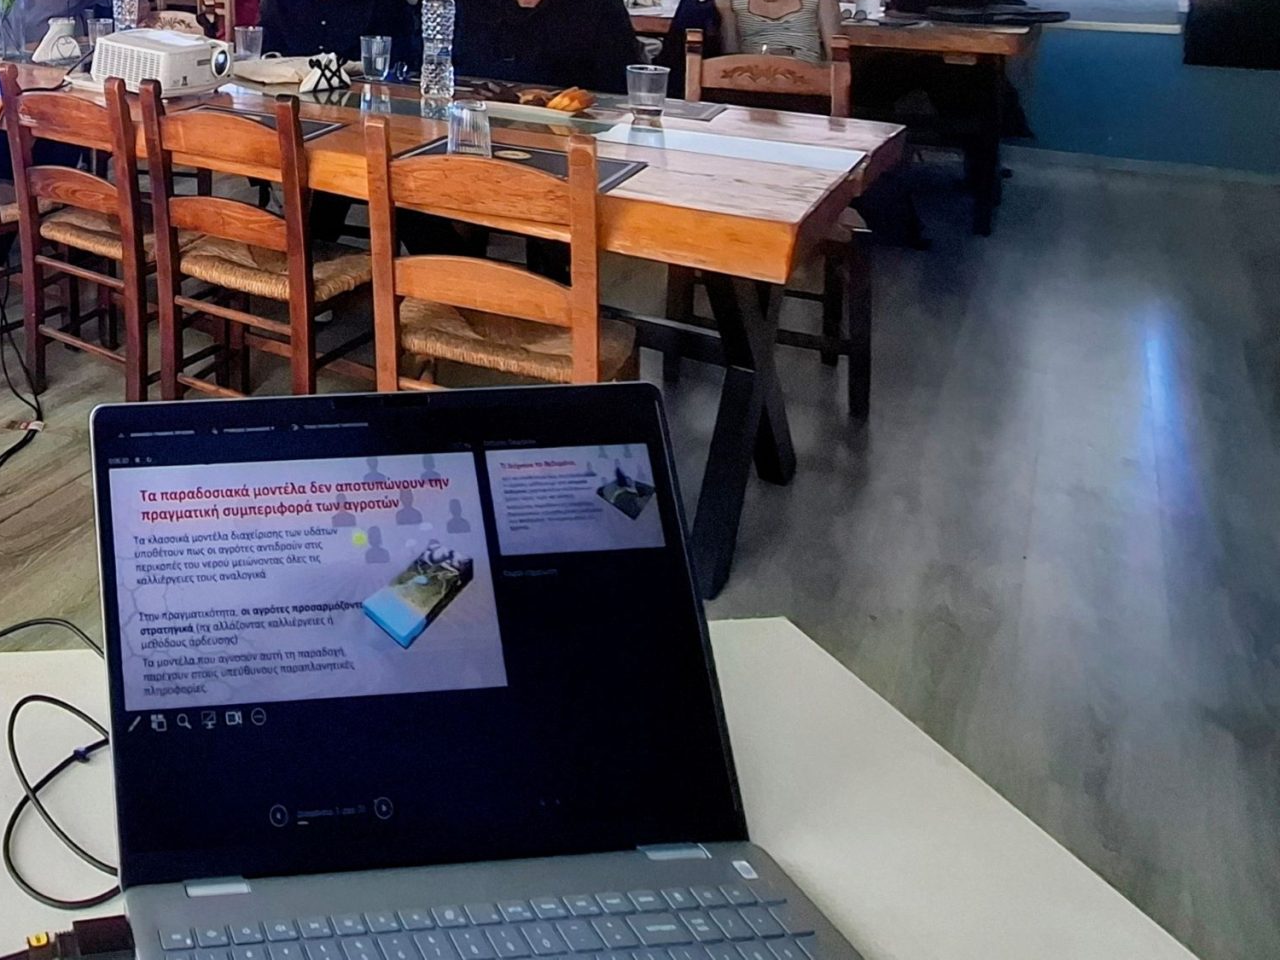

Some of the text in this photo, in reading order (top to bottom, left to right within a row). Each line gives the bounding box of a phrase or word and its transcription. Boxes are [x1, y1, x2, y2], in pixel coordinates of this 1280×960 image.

[140, 477, 450, 503] Τα παραδοσιακά μοντέλα δεν αποτυπώνουν την
[141, 495, 400, 522] πραγματική συμπεριφορά των αγροτών
[133, 536, 145, 545] Τα
[192, 531, 229, 543] μοντέλα
[231, 529, 284, 541] διαχείρισης
[285, 529, 302, 537] των
[304, 526, 338, 537] υδάτων
[134, 547, 184, 559] υποθέτουν
[187, 547, 205, 556] πως
[207, 547, 217, 555] οι
[218, 544, 255, 555] αγρότες
[136, 561, 181, 573] περικοπές
[184, 561, 200, 570] του
[202, 559, 229, 570] νερού
[196, 573, 218, 583] τους
[241, 607, 251, 616] οι
[252, 604, 290, 617] αγρότες
[292, 600, 363, 614] προσαρμόζοντ
[140, 623, 193, 636] στρατηγικά
